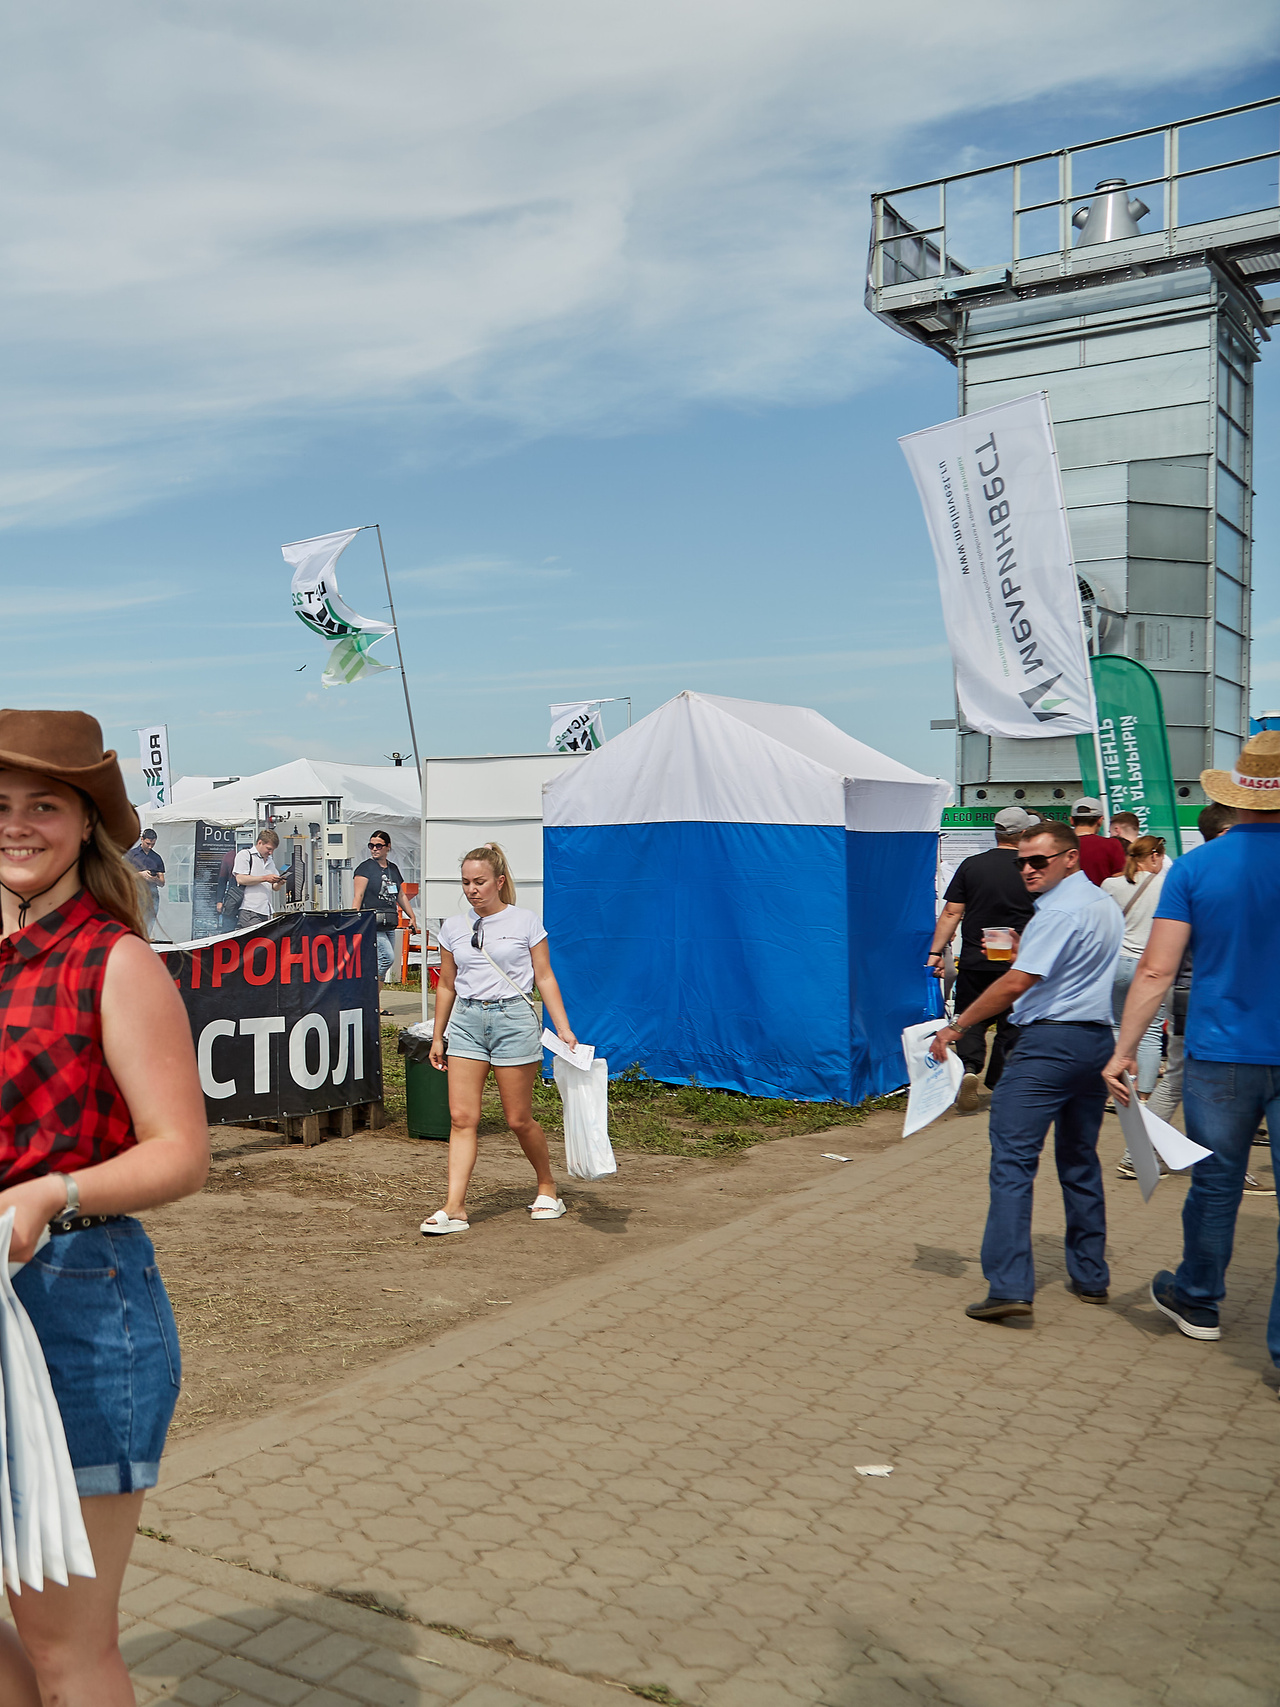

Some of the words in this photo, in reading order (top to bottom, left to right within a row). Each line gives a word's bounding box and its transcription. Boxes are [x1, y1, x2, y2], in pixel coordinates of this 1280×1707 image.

[953, 812, 972, 821] ECO
[162, 933, 363, 989] ТРОНОМ
[197, 1007, 364, 1100] СТОЛ
